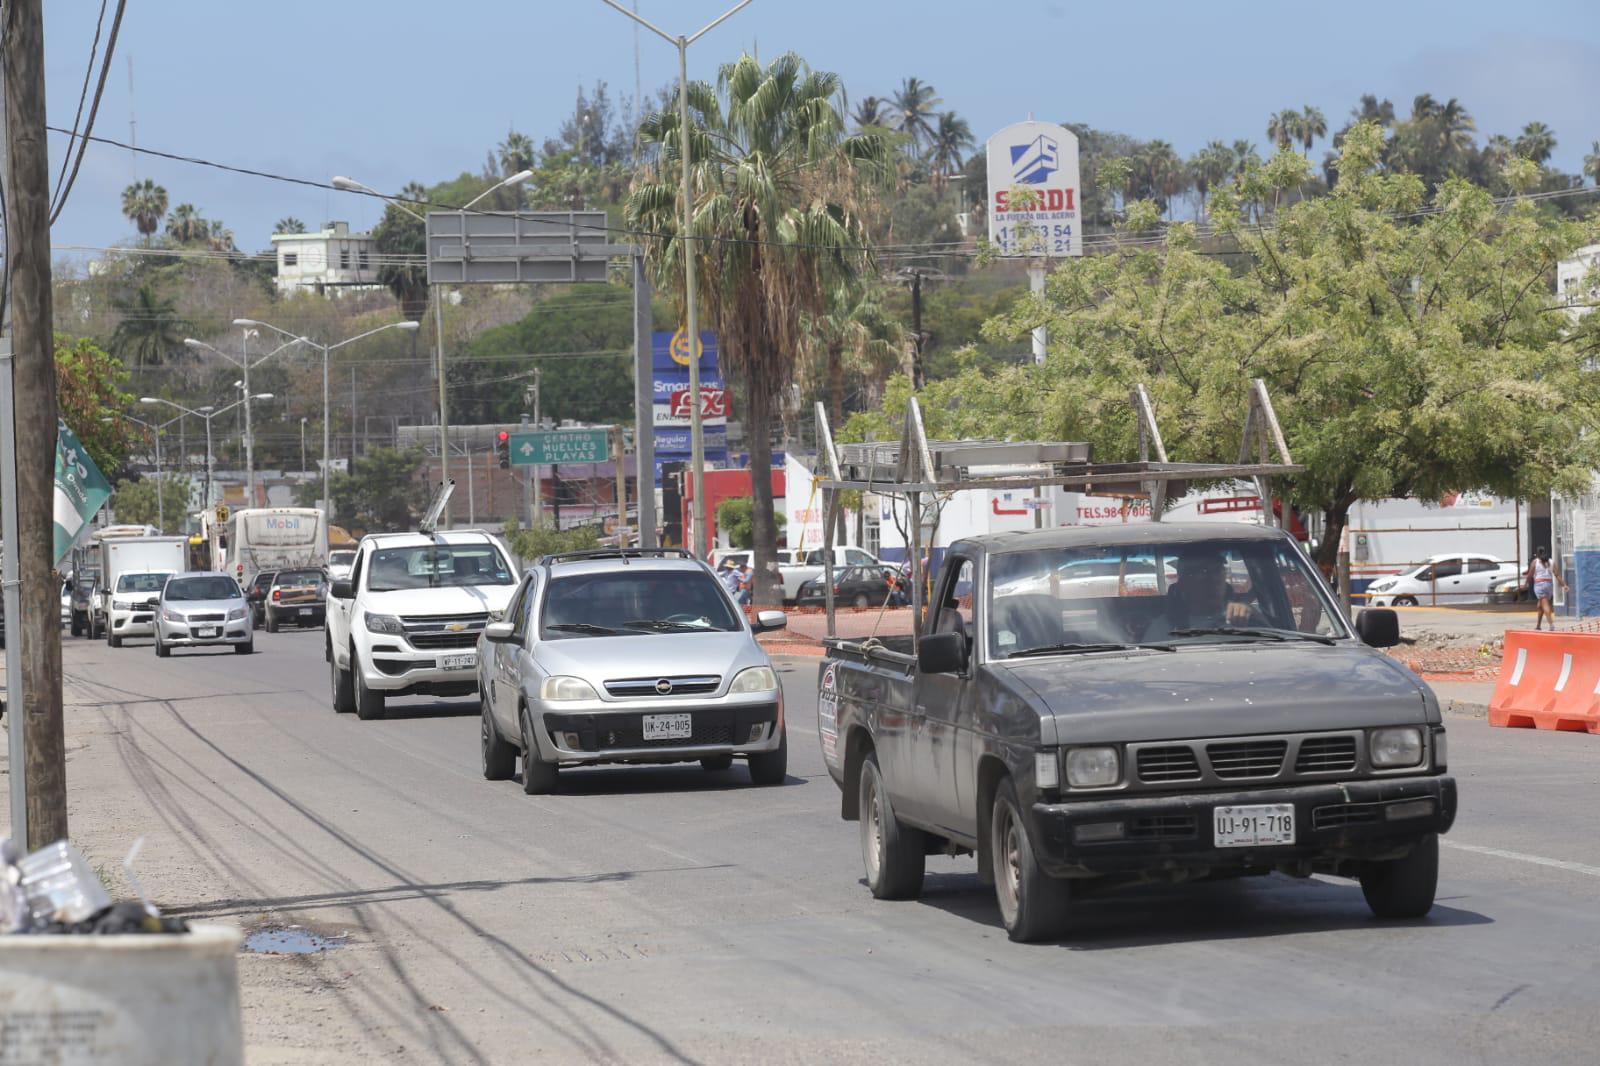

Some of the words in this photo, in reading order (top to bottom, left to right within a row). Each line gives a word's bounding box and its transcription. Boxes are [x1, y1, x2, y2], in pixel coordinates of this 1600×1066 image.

[1036, 212, 1049, 220] DEL
[1051, 211, 1076, 219] ACERO
[1053, 224, 1072, 237] 54
[1054, 239, 1072, 252] 21
[544, 433, 591, 443] CENTRO
[543, 442, 597, 452] MUELLES
[546, 451, 595, 461] PLAYAS
[266, 517, 300, 529] Mobil
[1217, 815, 1292, 835] UJ-91-718
